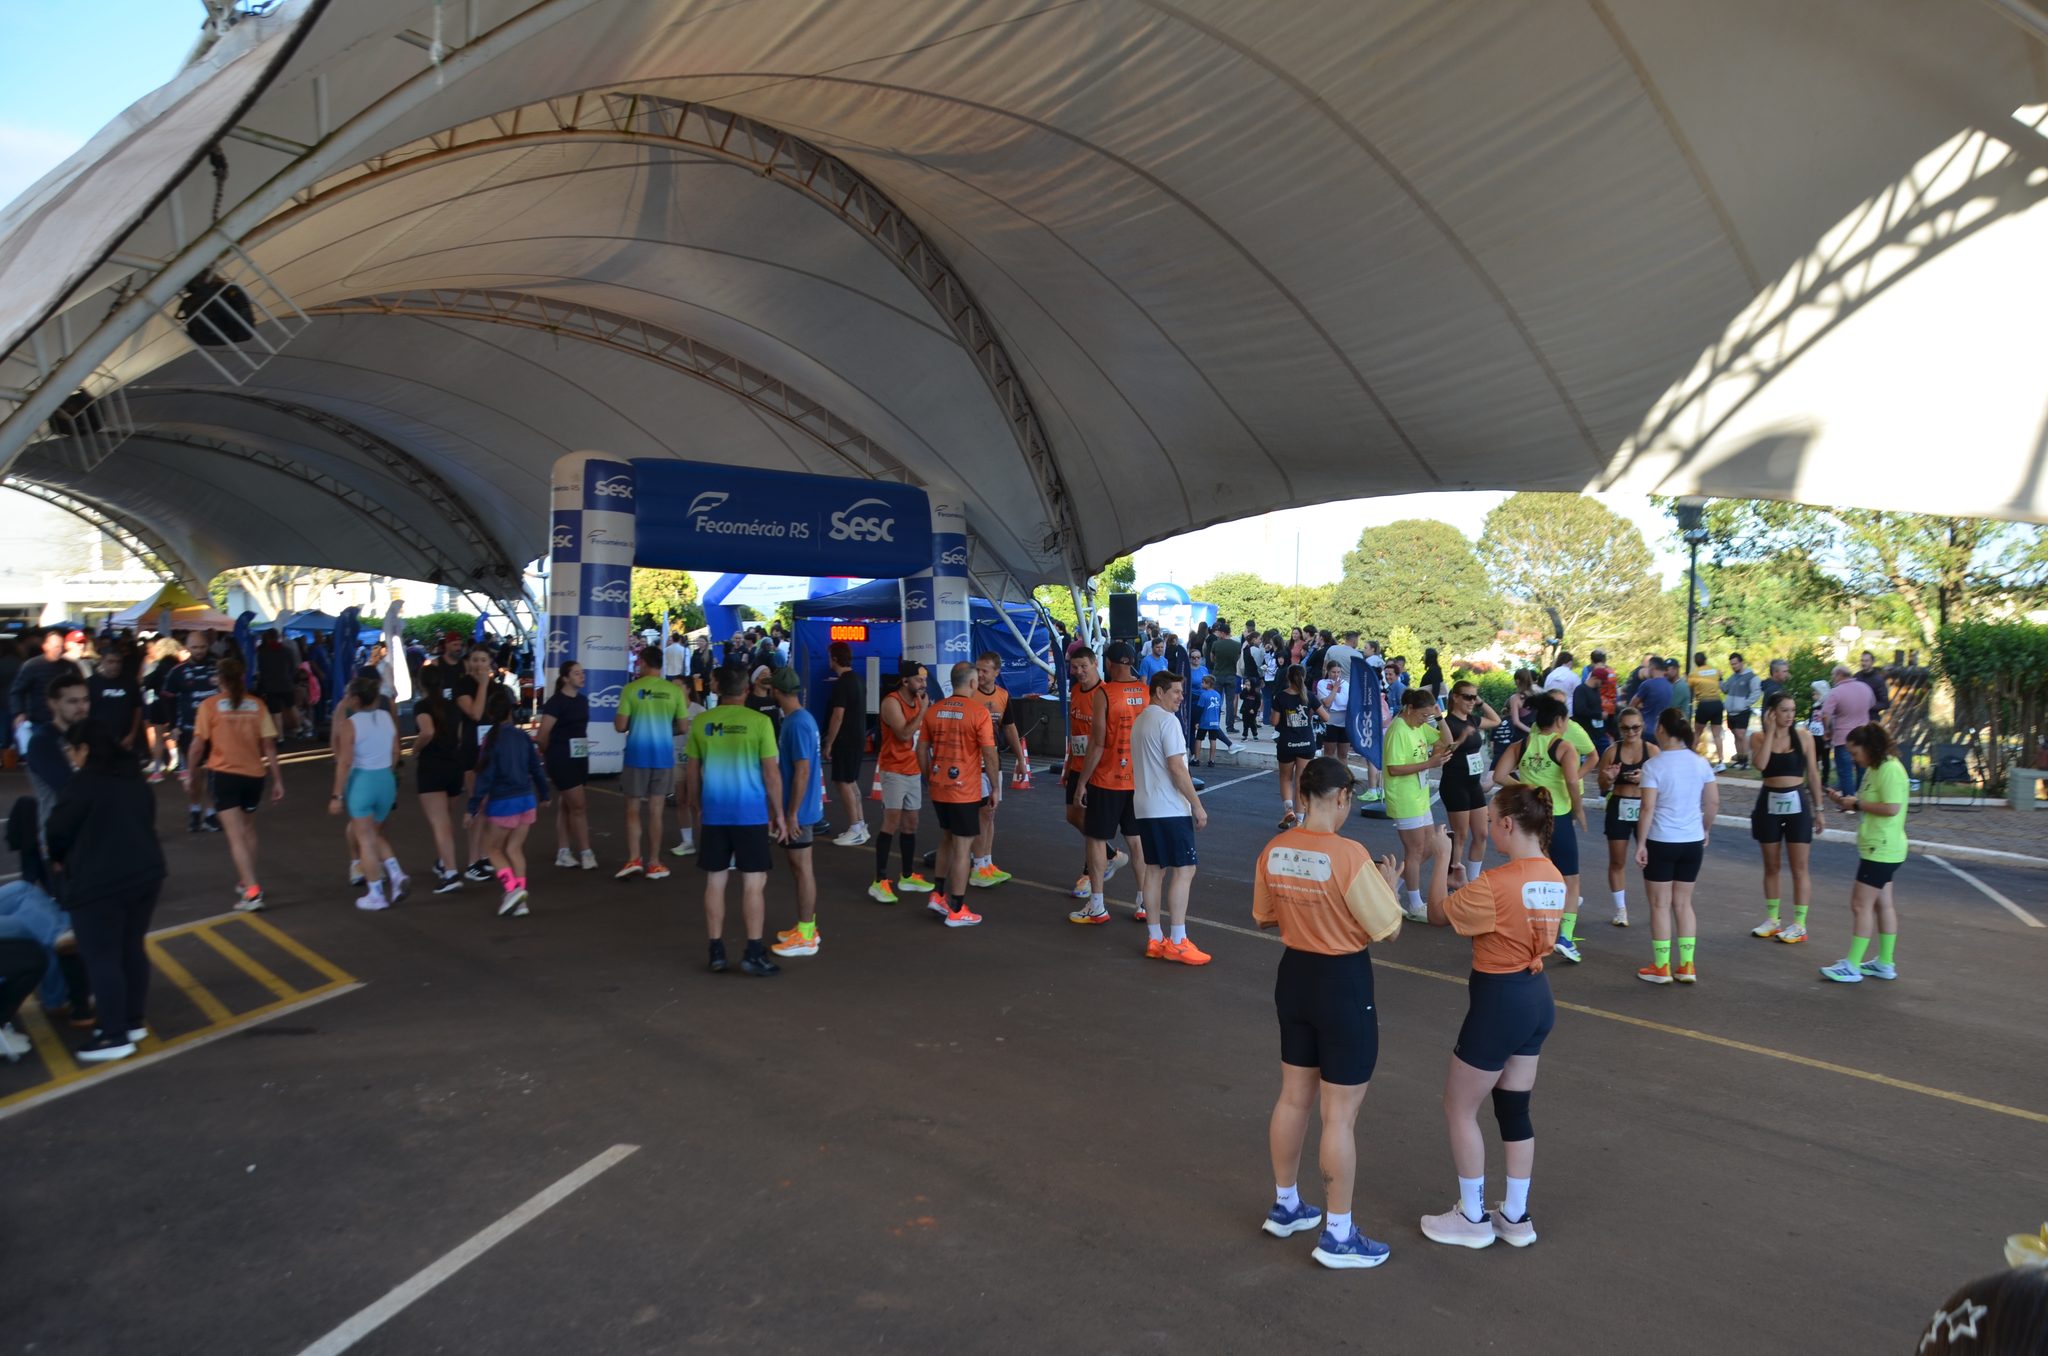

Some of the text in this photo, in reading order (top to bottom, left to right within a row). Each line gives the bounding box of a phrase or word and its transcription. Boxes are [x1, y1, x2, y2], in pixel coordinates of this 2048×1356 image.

[695, 516, 810, 539] Fecomércio RS
[828, 506, 895, 542] Sesc
[552, 534, 573, 547] esc
[905, 597, 928, 609] esc
[102, 689, 126, 697] FILA
[588, 691, 619, 707] Ses
[1361, 711, 1373, 748] Sesc
[1776, 801, 1792, 812] 77
